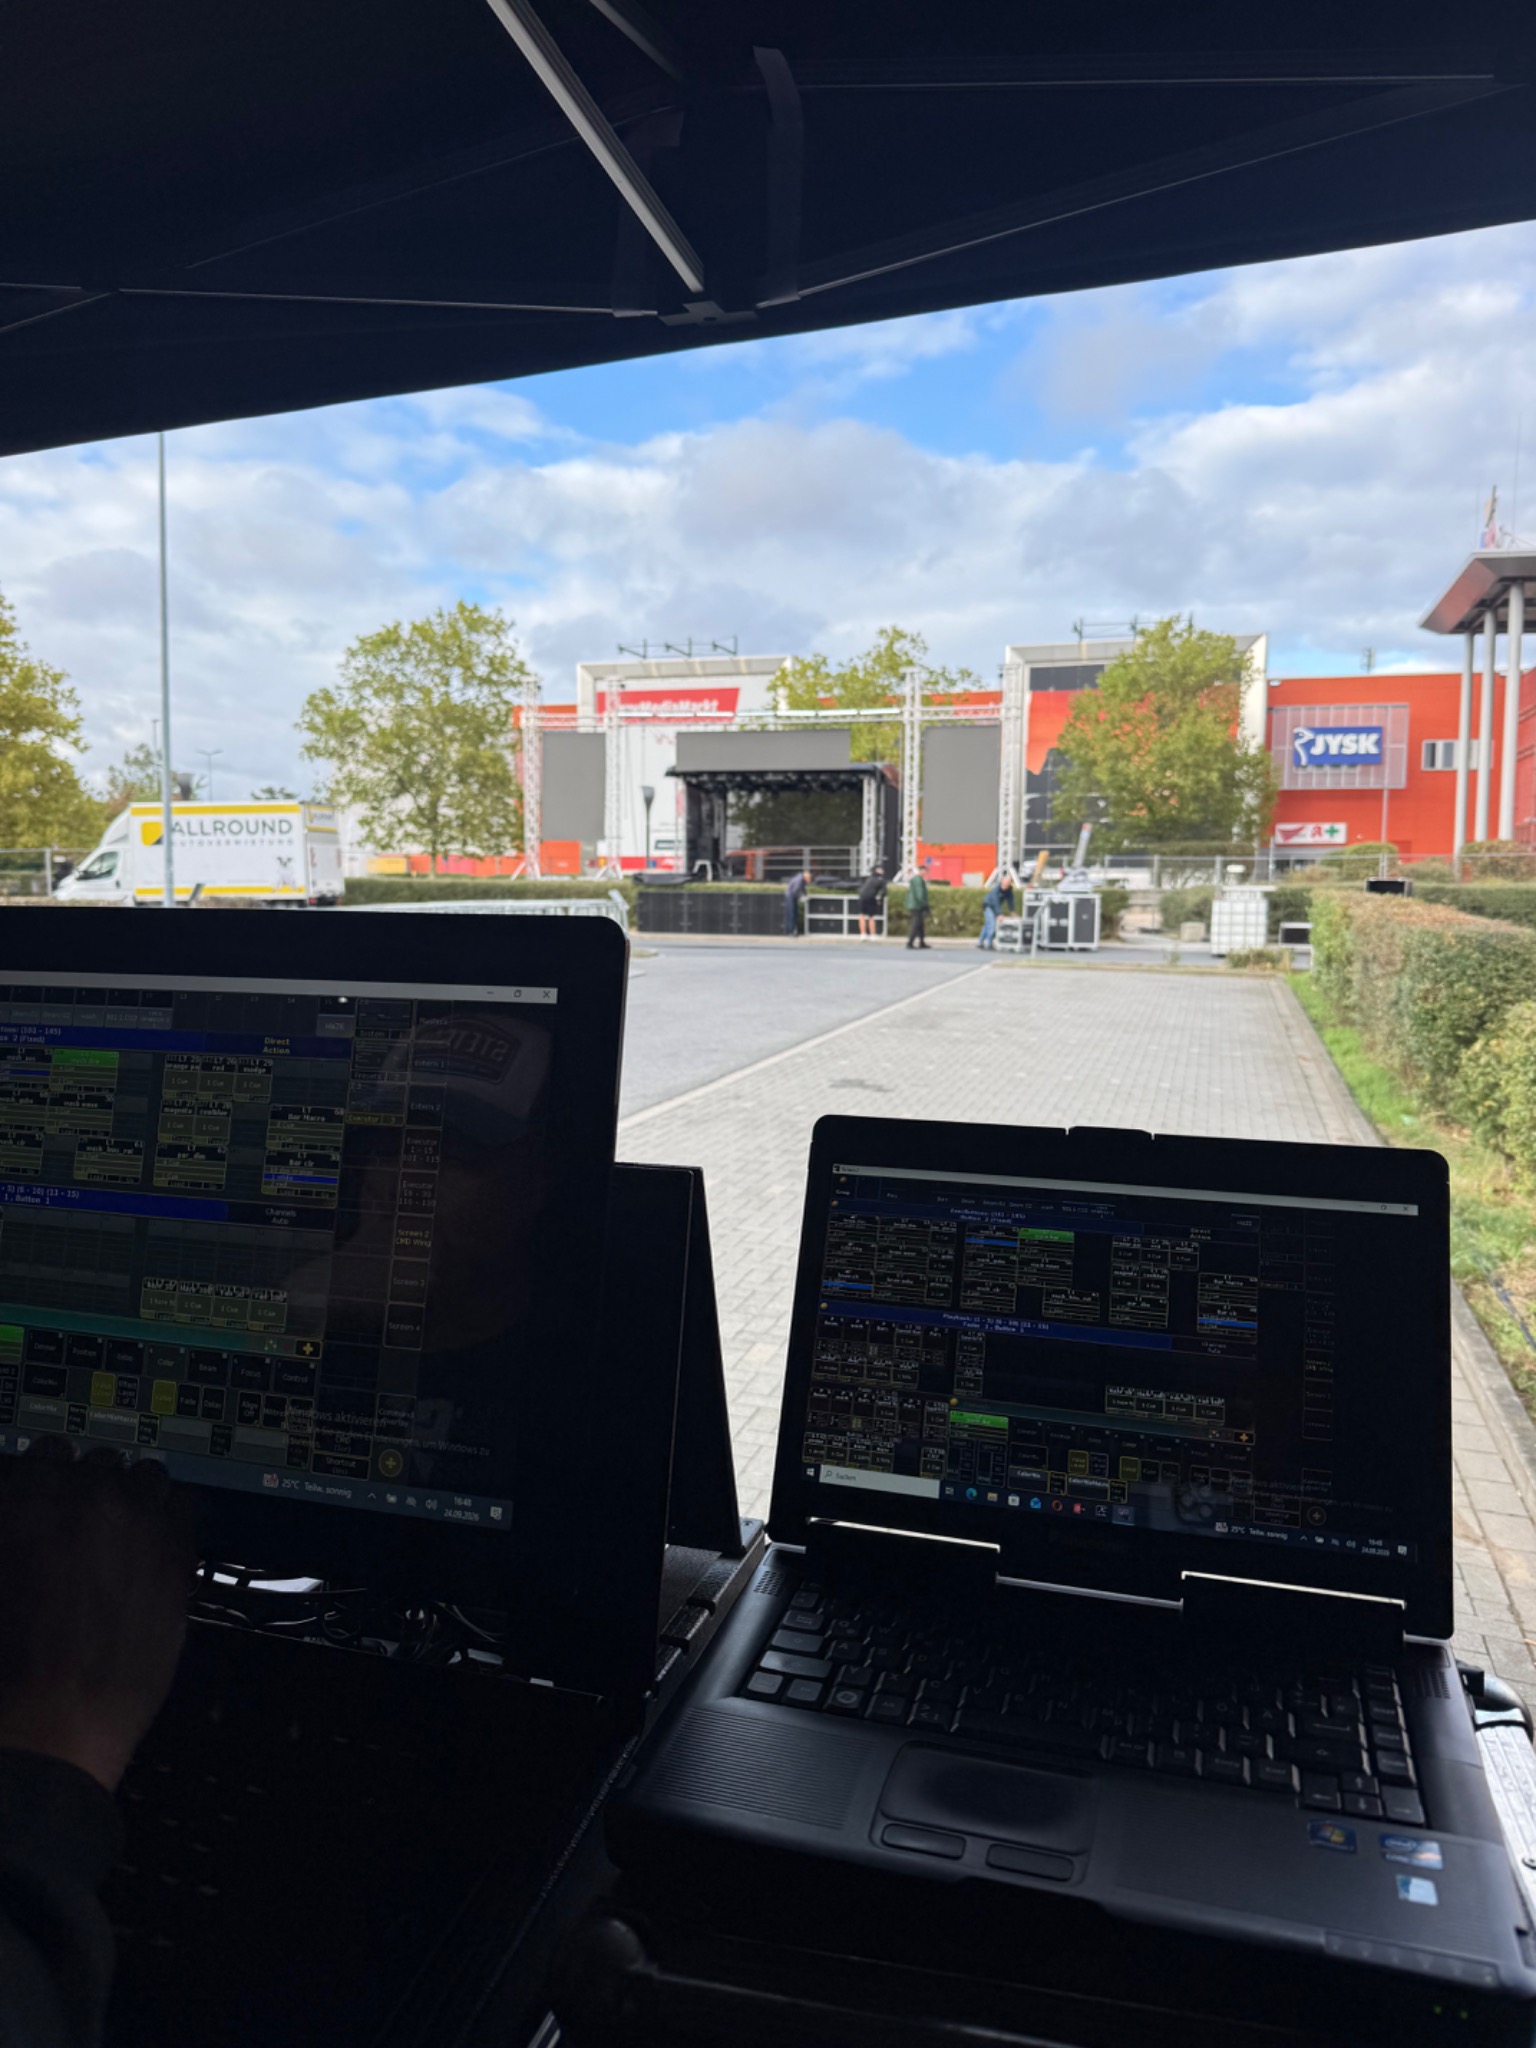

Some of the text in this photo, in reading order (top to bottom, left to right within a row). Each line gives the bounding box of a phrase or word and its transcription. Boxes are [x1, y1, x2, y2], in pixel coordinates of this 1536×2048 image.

[1309, 732, 1381, 755] JYSK
[172, 819, 292, 836] ALLROUND
[264, 1037, 290, 1046] Direct
[262, 1046, 290, 1055] Action
[406, 1138, 438, 1146] Executor
[16, 1195, 41, 1204] Button
[265, 1208, 296, 1217] Channels
[397, 1230, 421, 1238] Screen
[413, 1239, 432, 1248] Wing
[393, 1278, 416, 1287] Screen
[388, 1322, 415, 1331] Screen
[157, 1358, 174, 1367] Color
[198, 1364, 218, 1372] Beam
[240, 1368, 263, 1378] Focus
[282, 1373, 308, 1383] Control
[326, 1486, 352, 1499] sonnig
